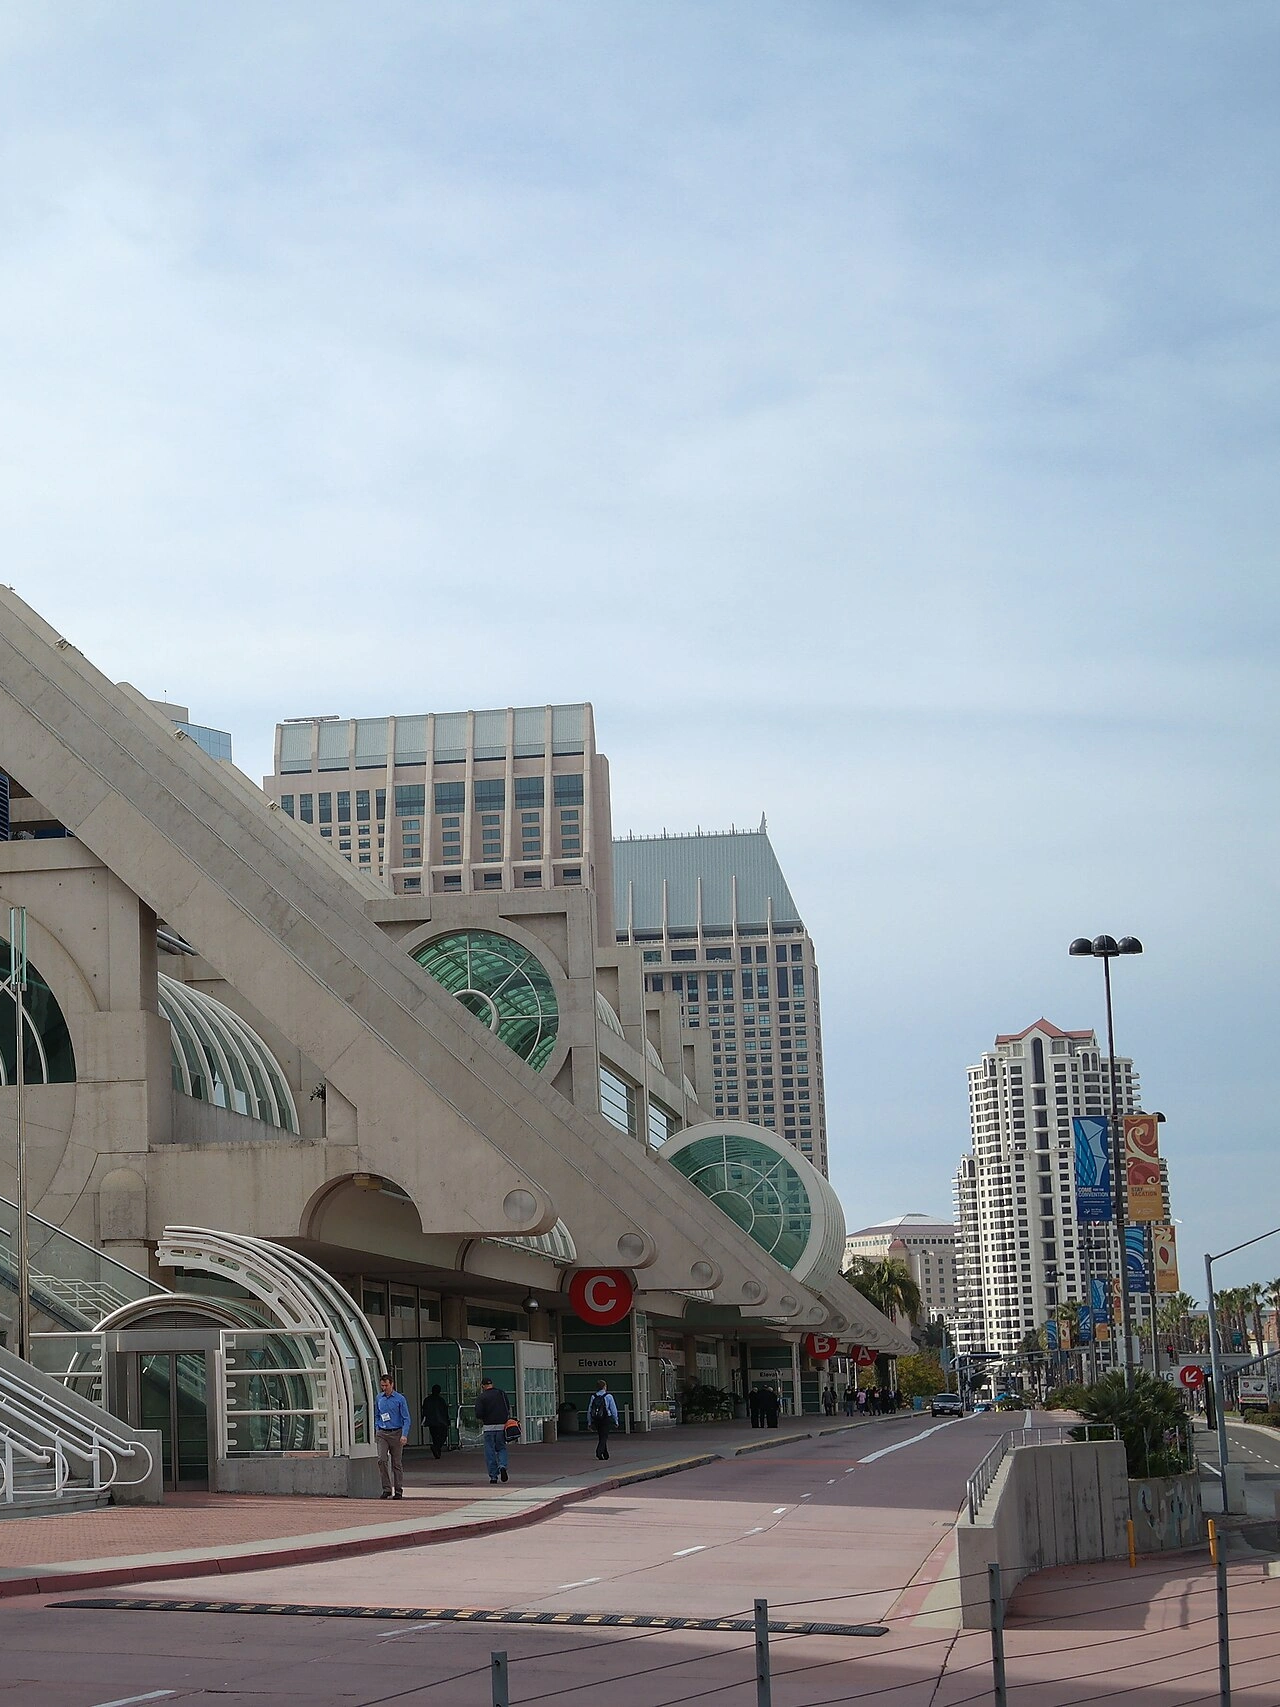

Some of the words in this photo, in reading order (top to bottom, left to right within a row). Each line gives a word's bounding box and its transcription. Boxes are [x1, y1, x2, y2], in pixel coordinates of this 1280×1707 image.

[584, 1275, 617, 1312] C
[813, 1335, 830, 1354] B
[857, 1345, 872, 1361] A
[578, 1359, 617, 1367] Elevator
